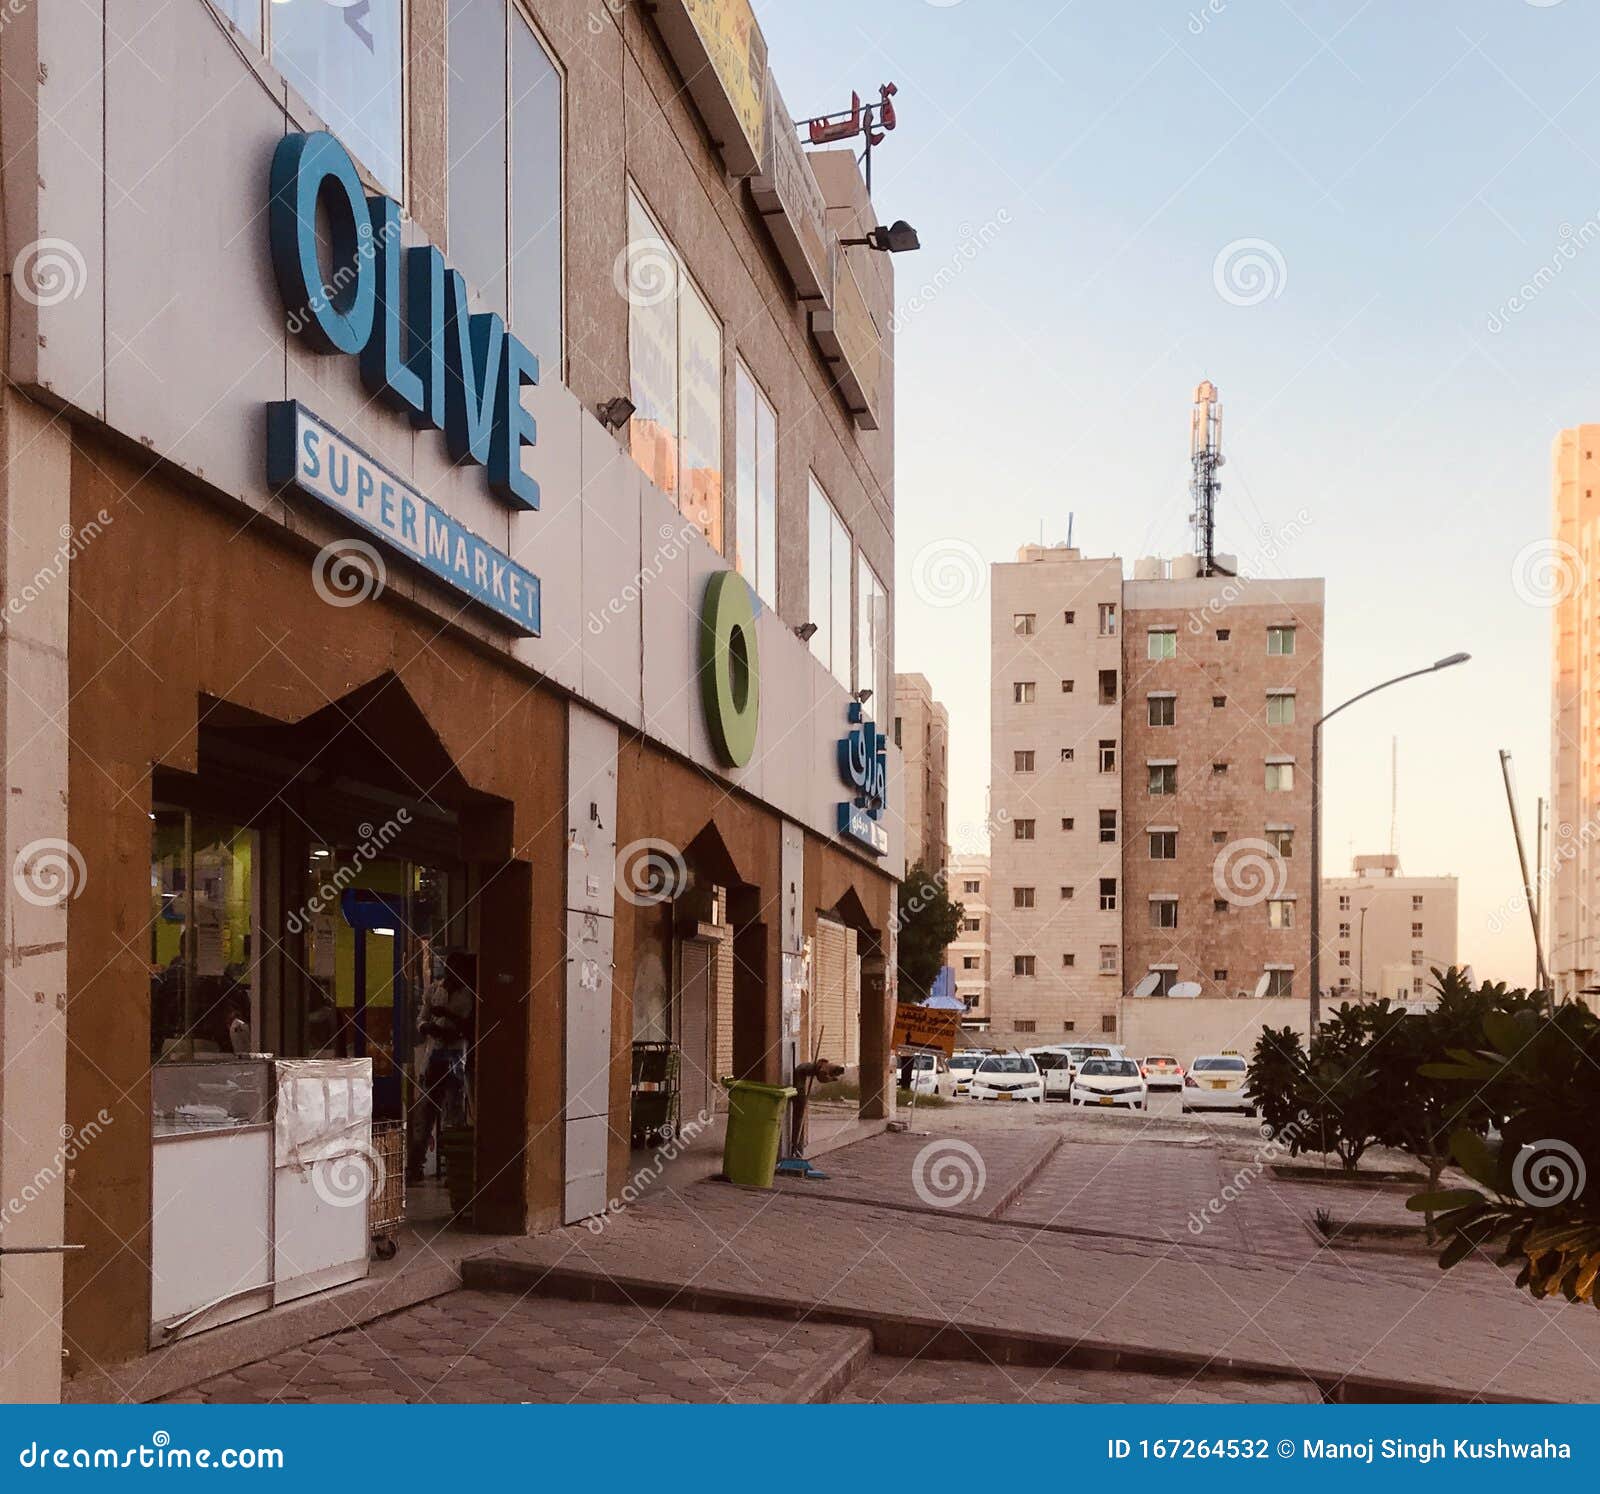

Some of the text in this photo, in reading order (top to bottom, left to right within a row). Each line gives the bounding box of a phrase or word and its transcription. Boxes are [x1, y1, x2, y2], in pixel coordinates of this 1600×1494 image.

[270, 130, 540, 511] OLIVE
[303, 429, 537, 619] SUPER MARKET
